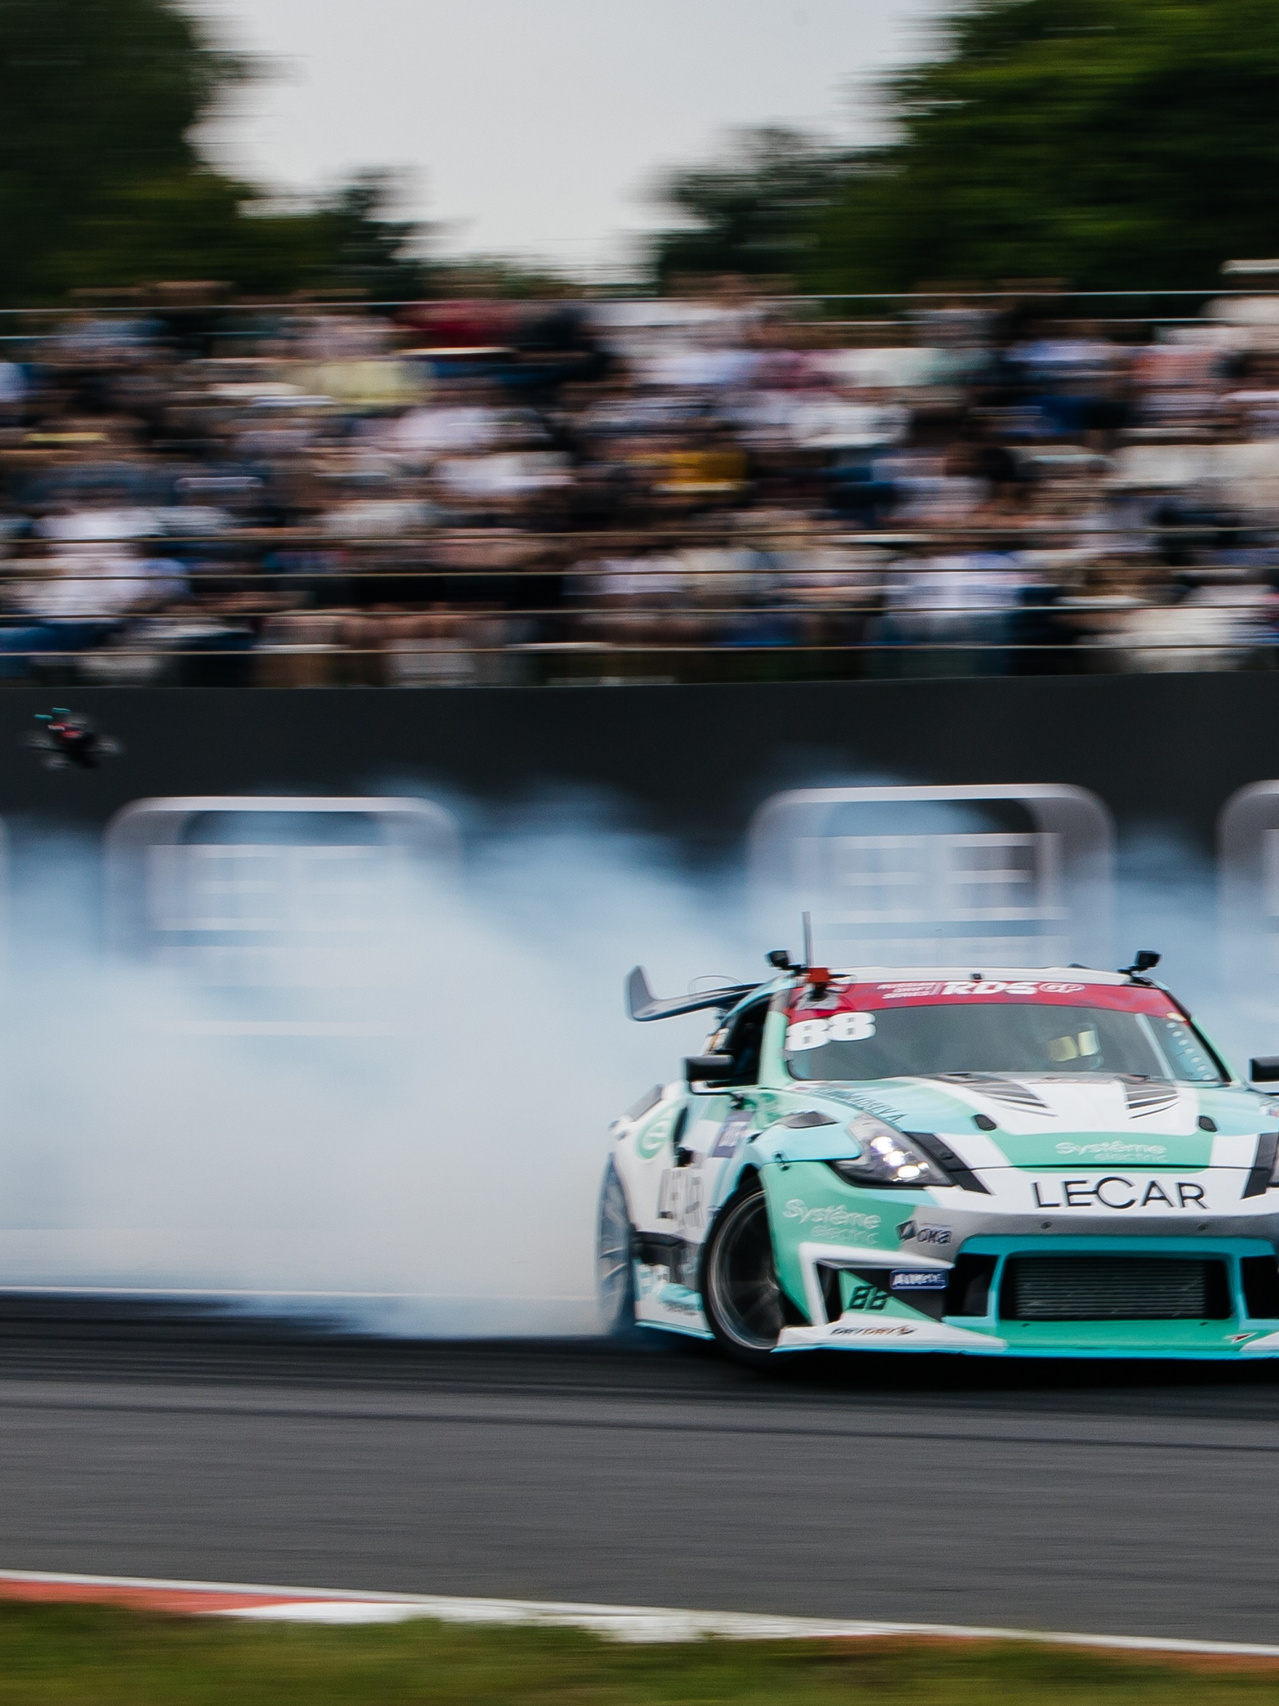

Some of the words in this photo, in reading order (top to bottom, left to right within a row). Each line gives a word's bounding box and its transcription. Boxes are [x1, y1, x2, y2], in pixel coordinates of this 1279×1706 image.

[941, 981, 1039, 995] RDS
[785, 1012, 876, 1051] 88
[1031, 1175, 1210, 1210] LECAR
